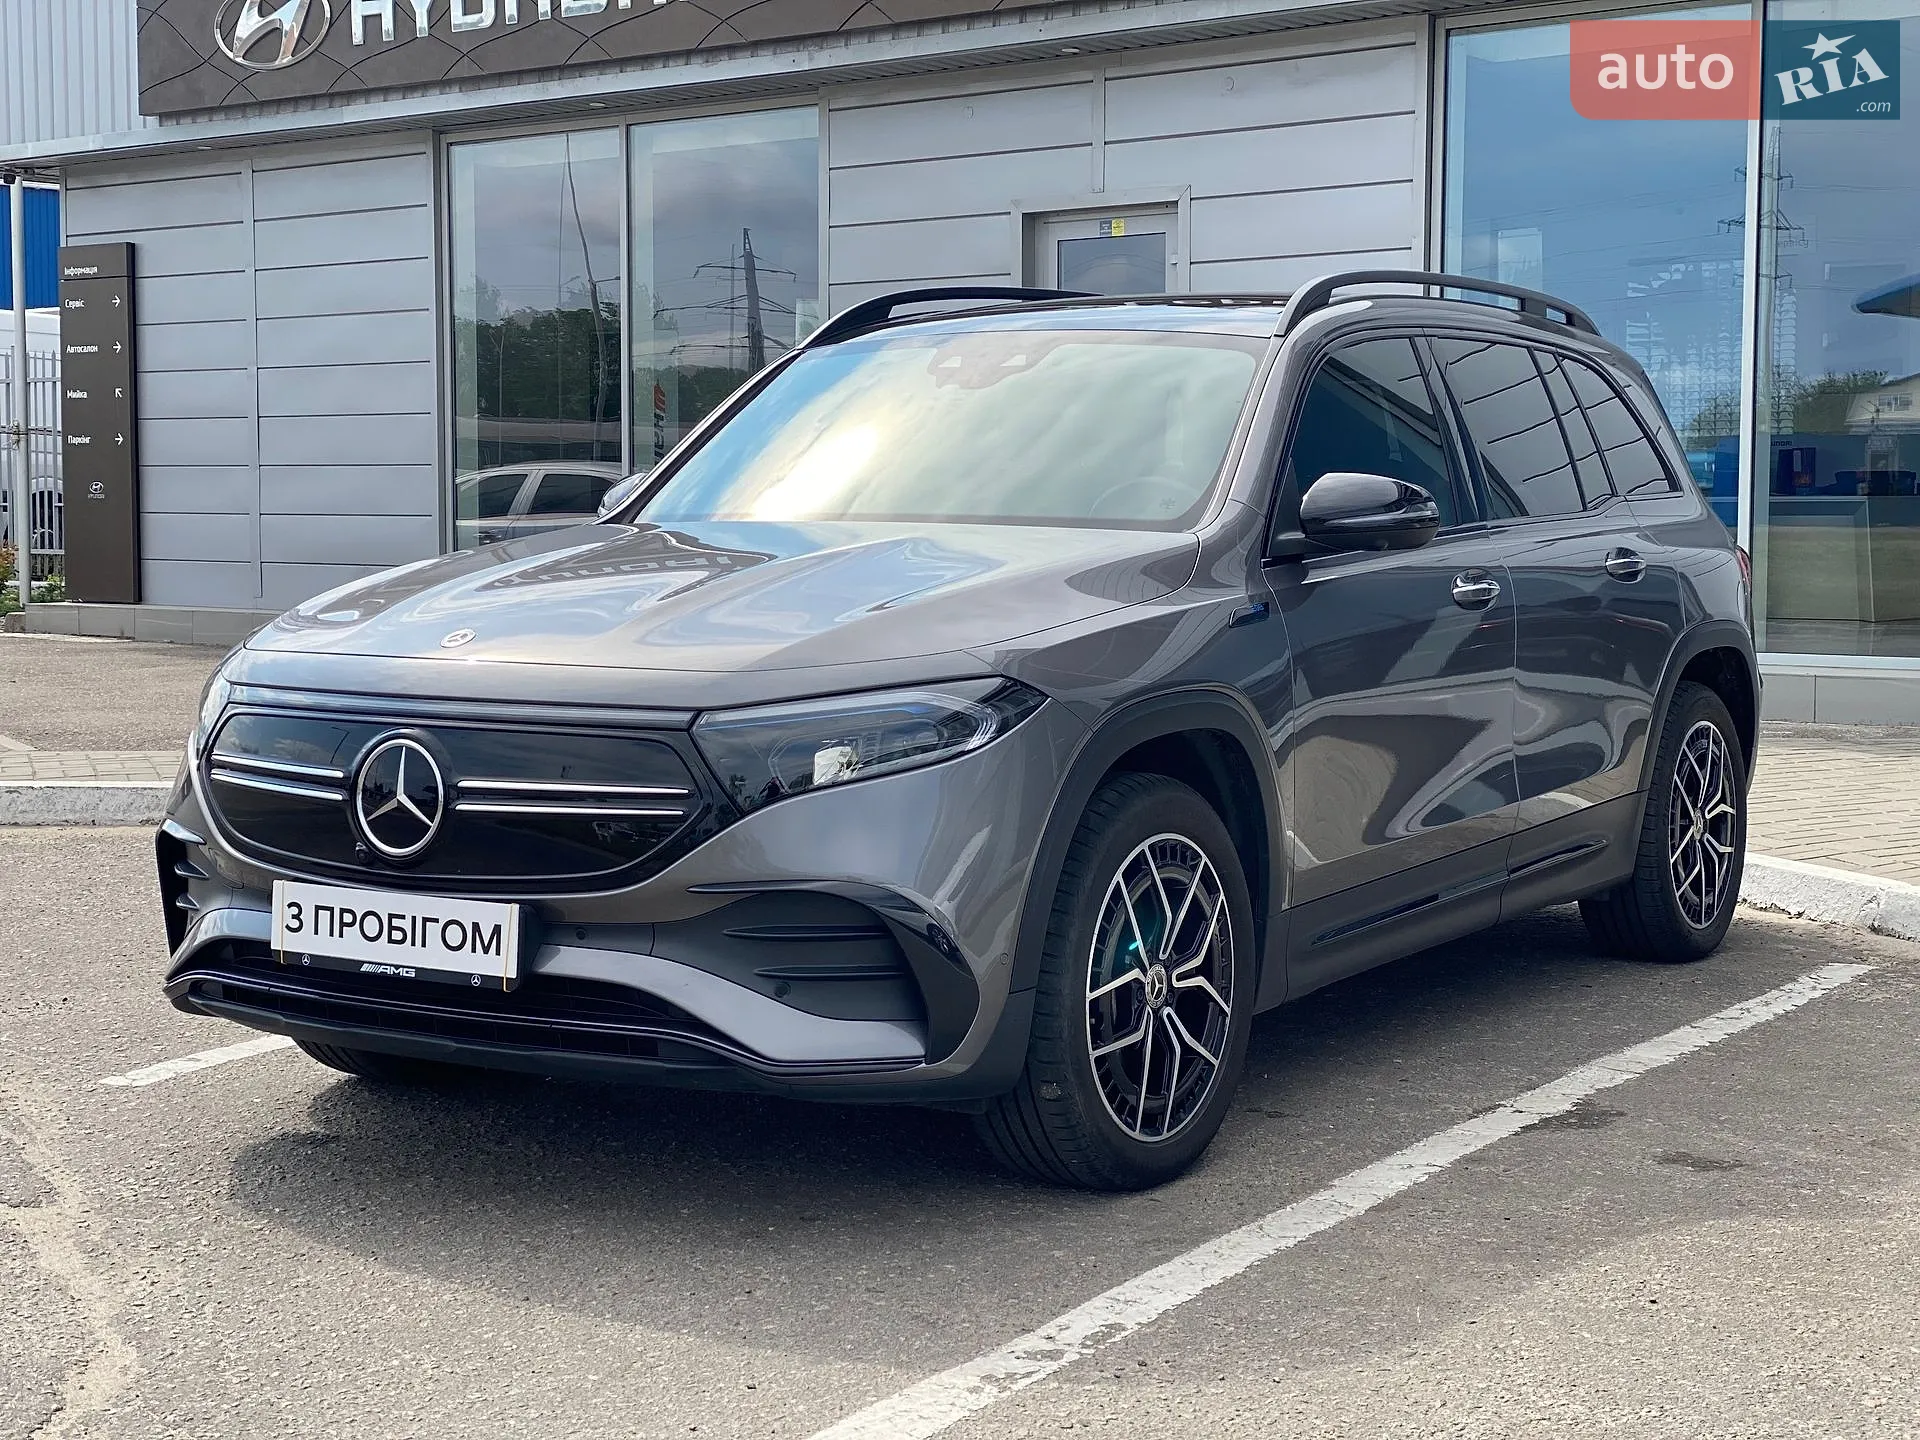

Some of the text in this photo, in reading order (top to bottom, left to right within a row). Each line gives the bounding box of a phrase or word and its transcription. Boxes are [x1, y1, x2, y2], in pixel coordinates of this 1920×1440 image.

[65, 298, 85, 309] Сервіс
[66, 344, 98, 354] Автосалон
[66, 389, 88, 399] Мийка
[67, 434, 91, 445] Паркінг
[313, 904, 502, 956] ПРОБІГОМ
